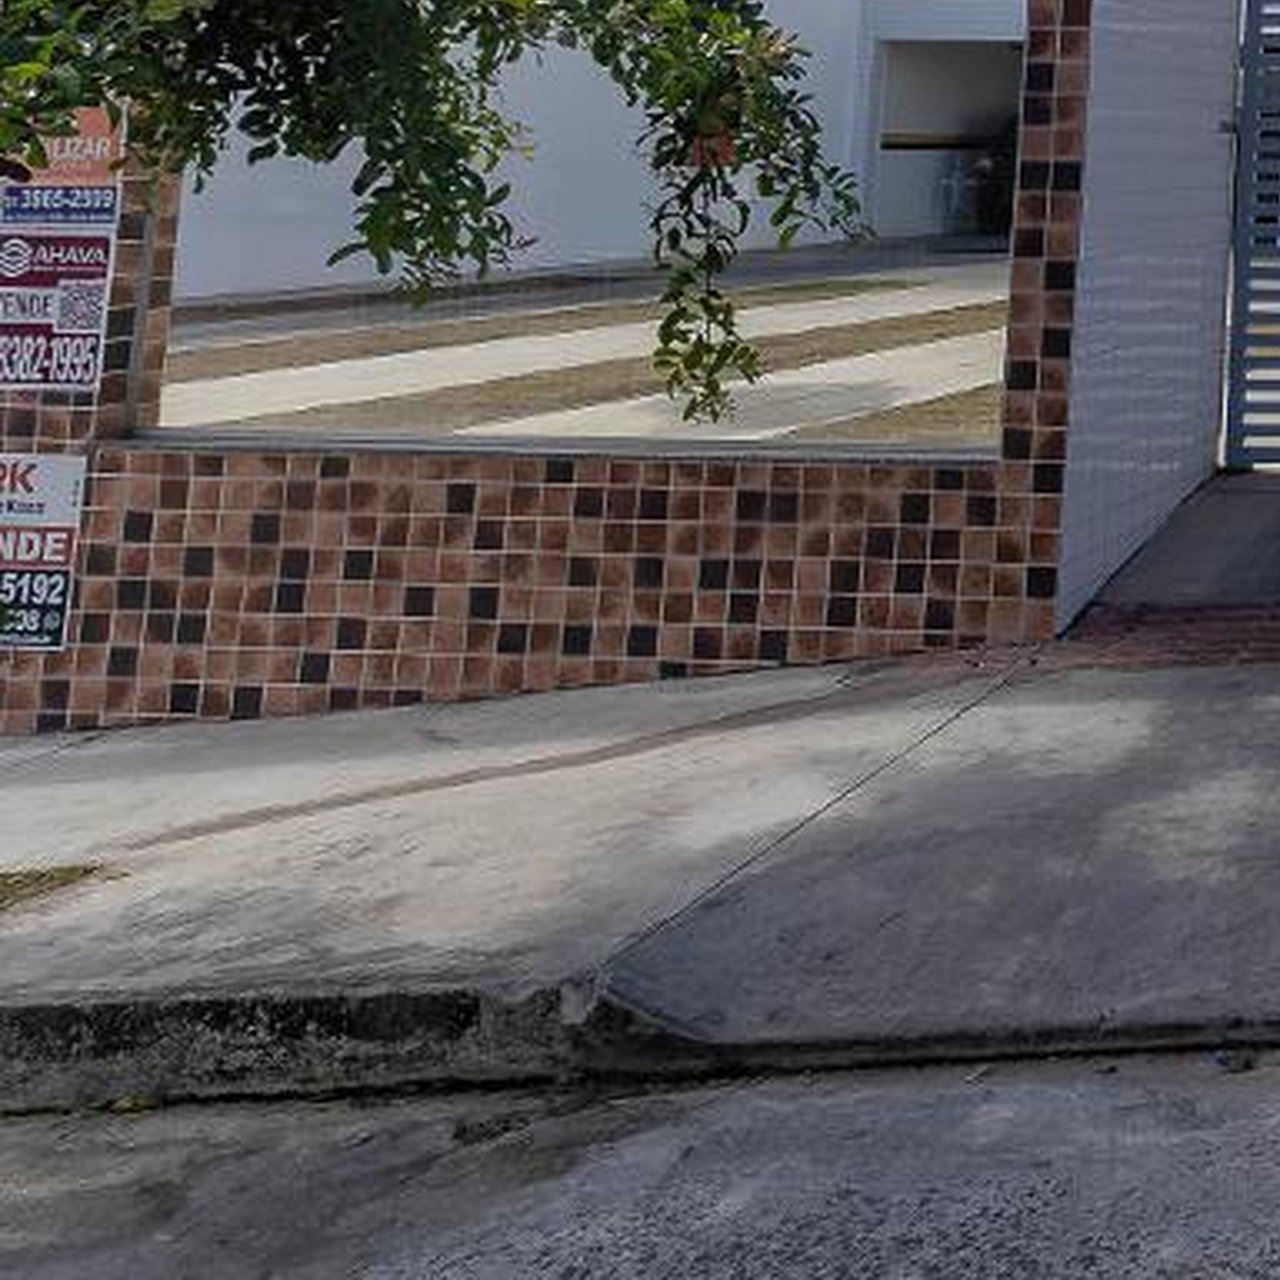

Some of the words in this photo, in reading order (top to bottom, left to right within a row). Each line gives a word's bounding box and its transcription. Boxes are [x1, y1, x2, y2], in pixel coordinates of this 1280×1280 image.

[32, 243, 107, 265] AHAVA
[0, 291, 53, 318] ENDE
[0, 572, 64, 605] 5192
